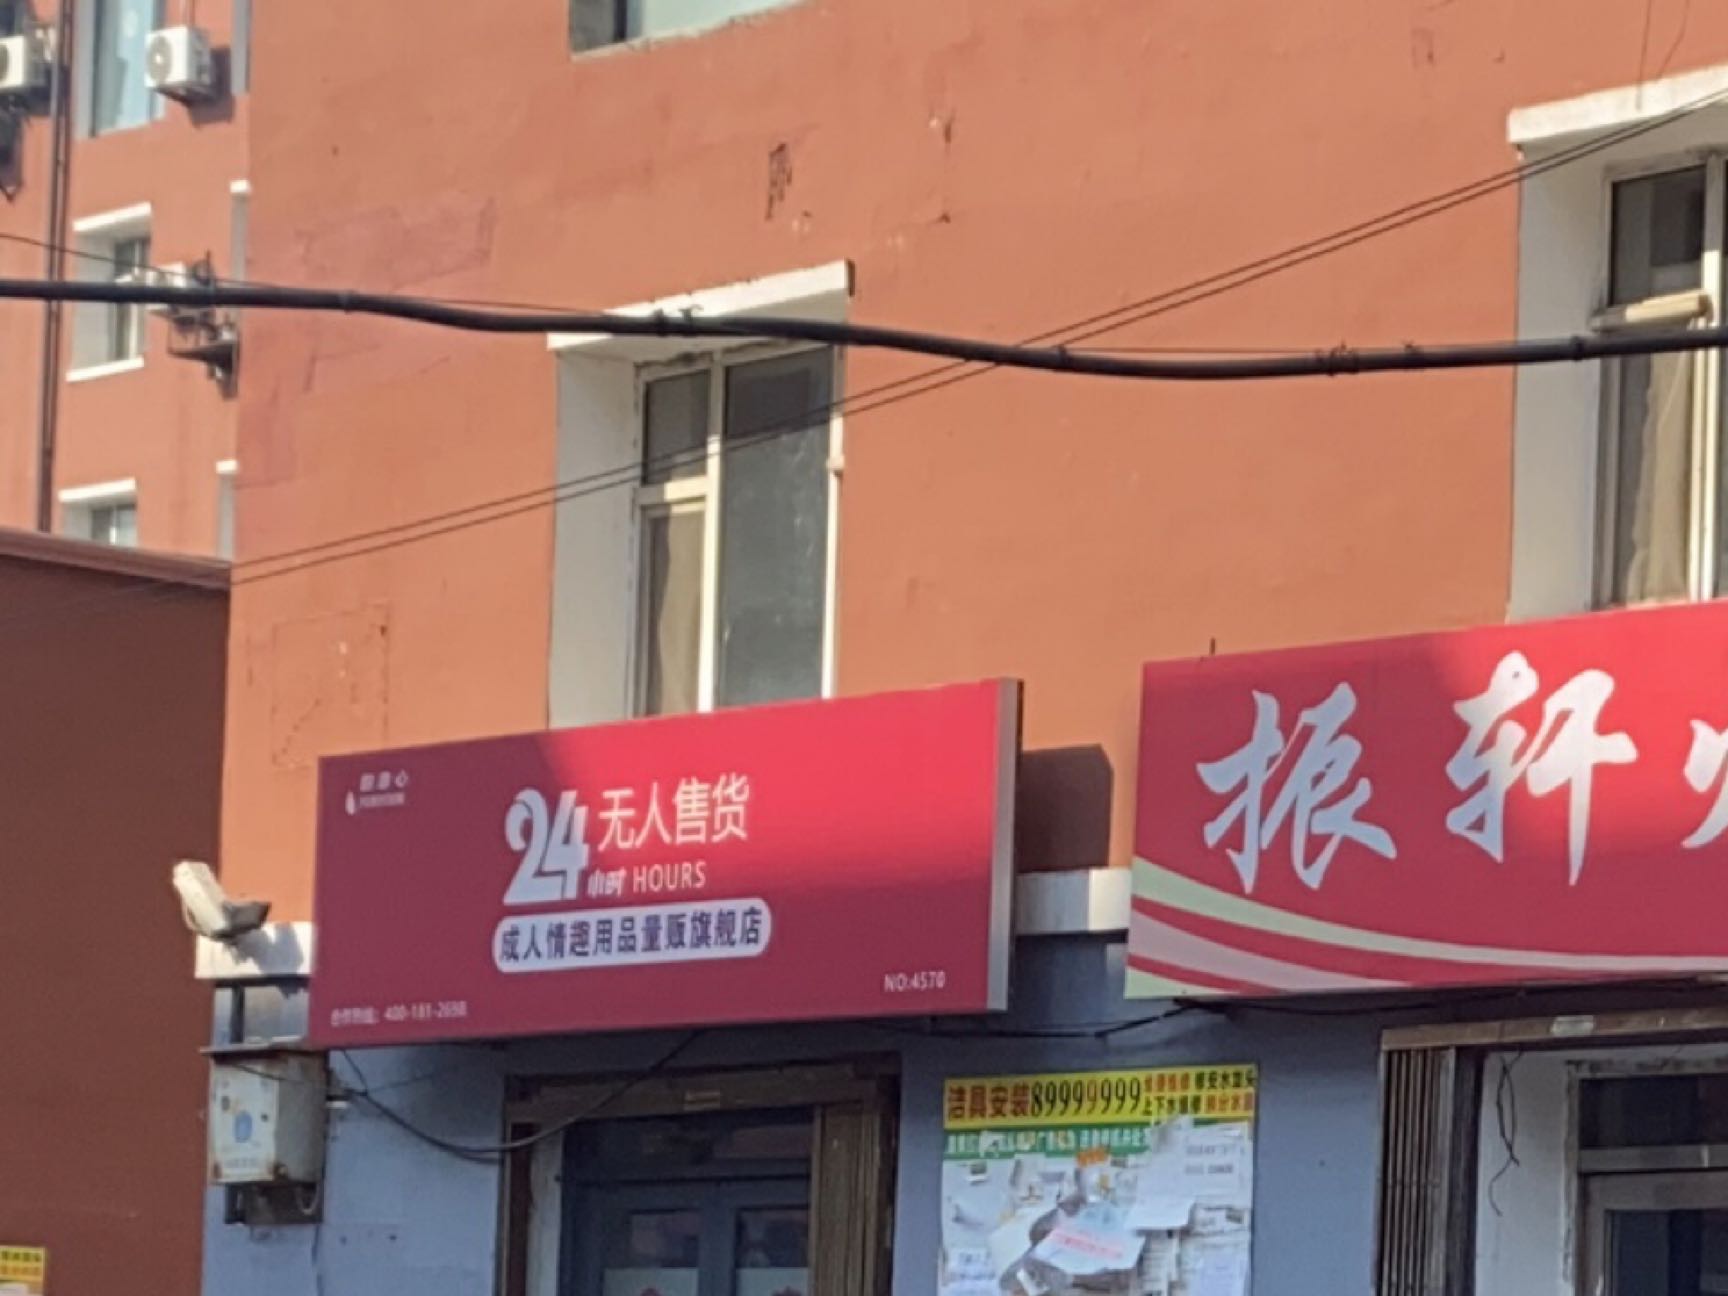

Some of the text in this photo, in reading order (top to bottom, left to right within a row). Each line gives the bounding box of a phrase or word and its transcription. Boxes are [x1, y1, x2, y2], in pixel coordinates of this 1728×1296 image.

[598, 772, 751, 852] 无人售货
[503, 788, 590, 906] 24
[587, 861, 707, 897] 小时 HOURS
[500, 906, 763, 962] 成人情趣用品量贩旗舰店
